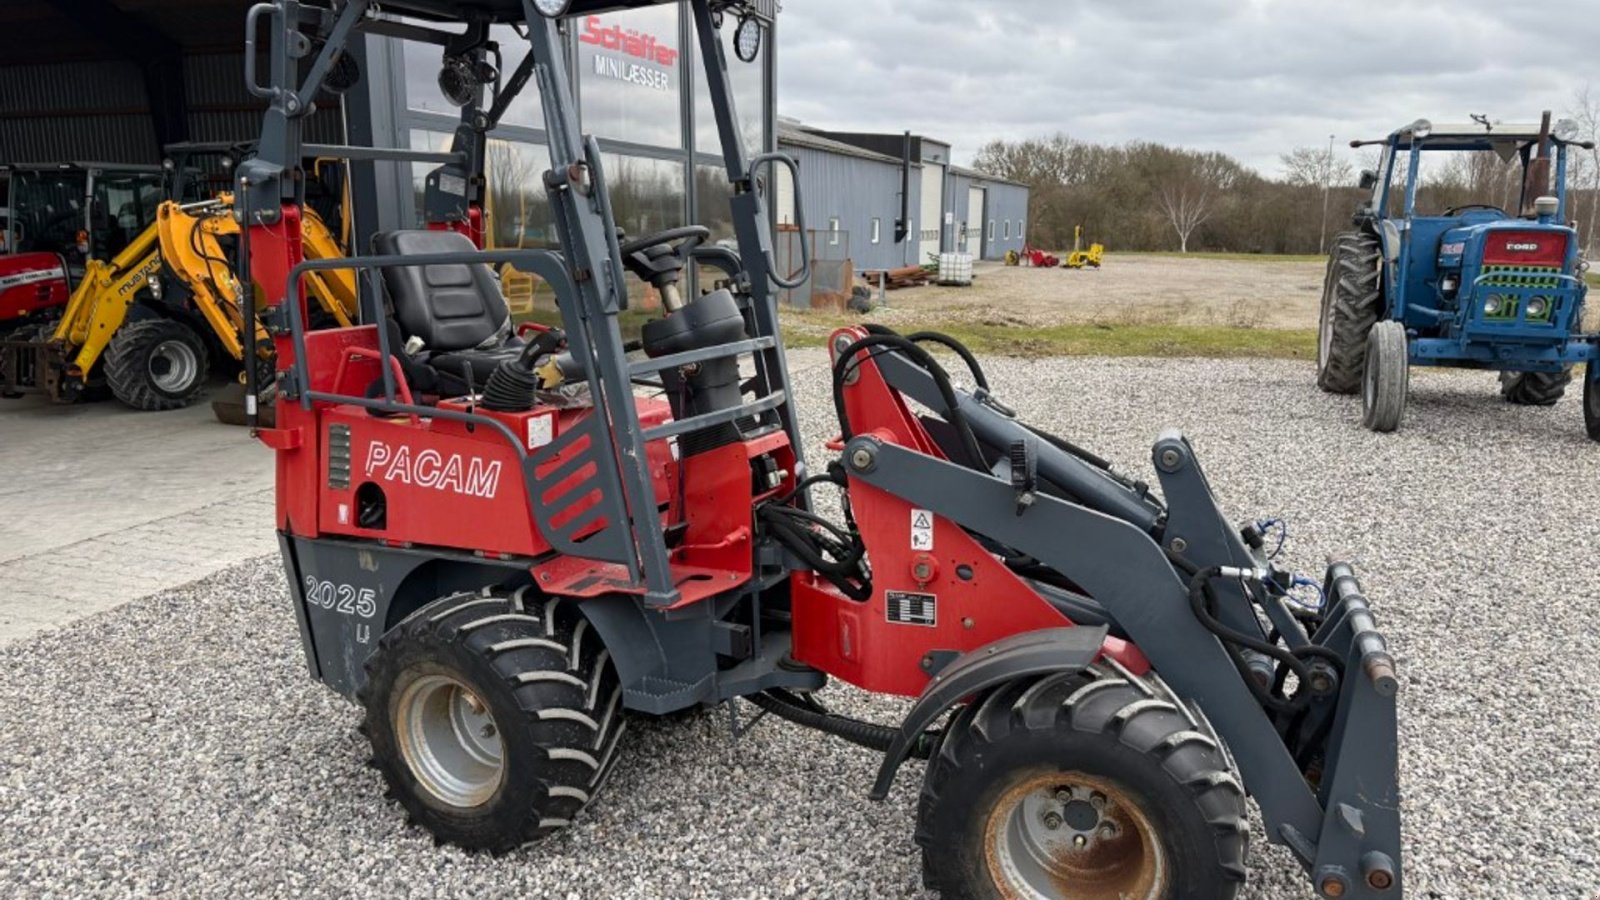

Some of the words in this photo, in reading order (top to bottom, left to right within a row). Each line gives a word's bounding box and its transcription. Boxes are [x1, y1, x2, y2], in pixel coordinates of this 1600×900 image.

[579, 15, 677, 66] Schäffer
[594, 54, 669, 91] MINILÆSSER
[1506, 242, 1537, 250] FORD
[365, 440, 502, 498] PACAM
[306, 574, 376, 618] 2025
